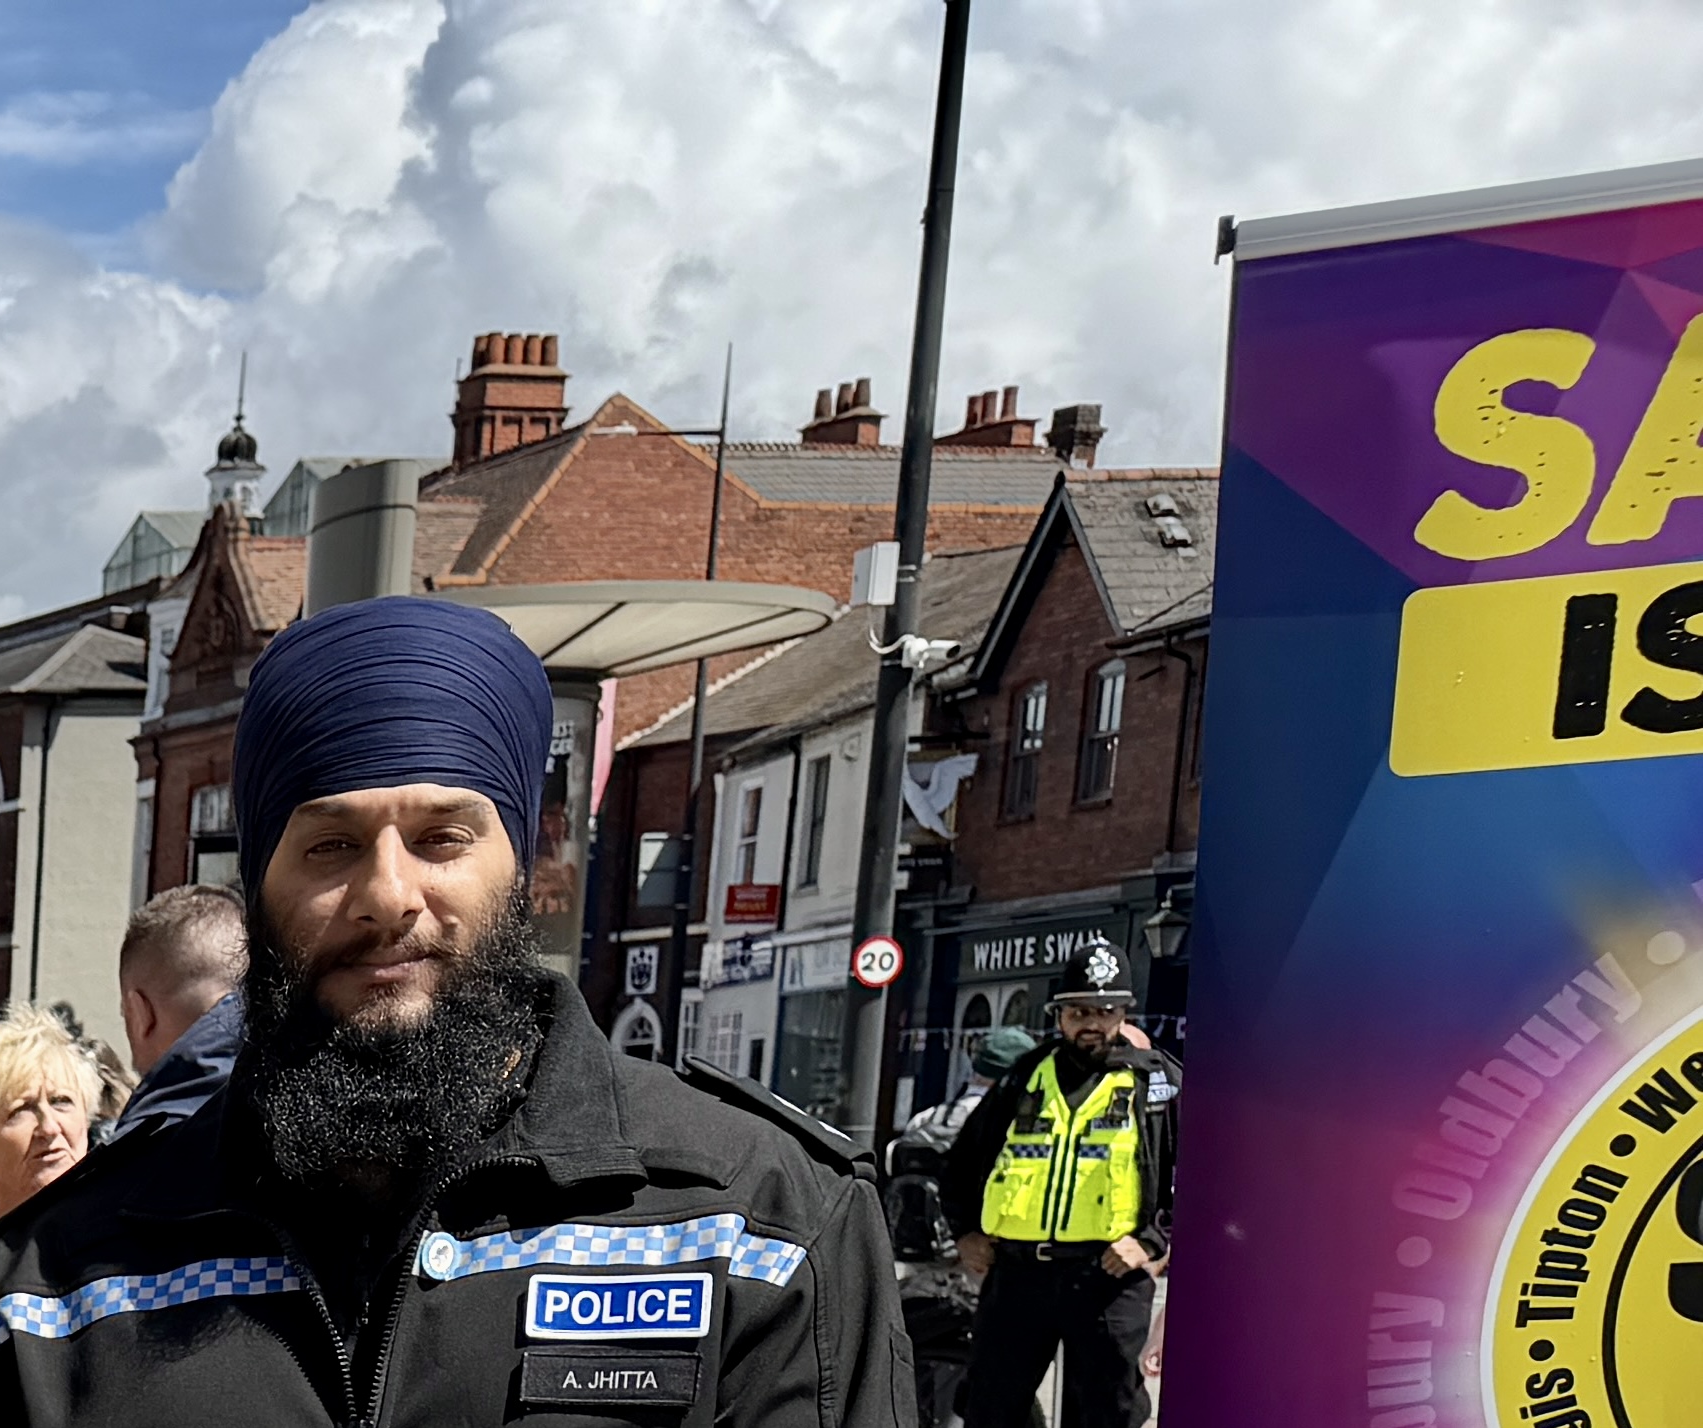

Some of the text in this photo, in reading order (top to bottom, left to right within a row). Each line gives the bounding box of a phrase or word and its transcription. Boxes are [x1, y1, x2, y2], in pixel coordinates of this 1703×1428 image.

[1413, 311, 1703, 561] SA
[861, 951, 895, 972] 20
[974, 936, 1037, 972] WHITE
[1397, 949, 1644, 1224] Oldbury
[1515, 1165, 1630, 1330] Tipton
[545, 1288, 693, 1325] POLICE
[562, 1370, 658, 1389] A. JHITTA
